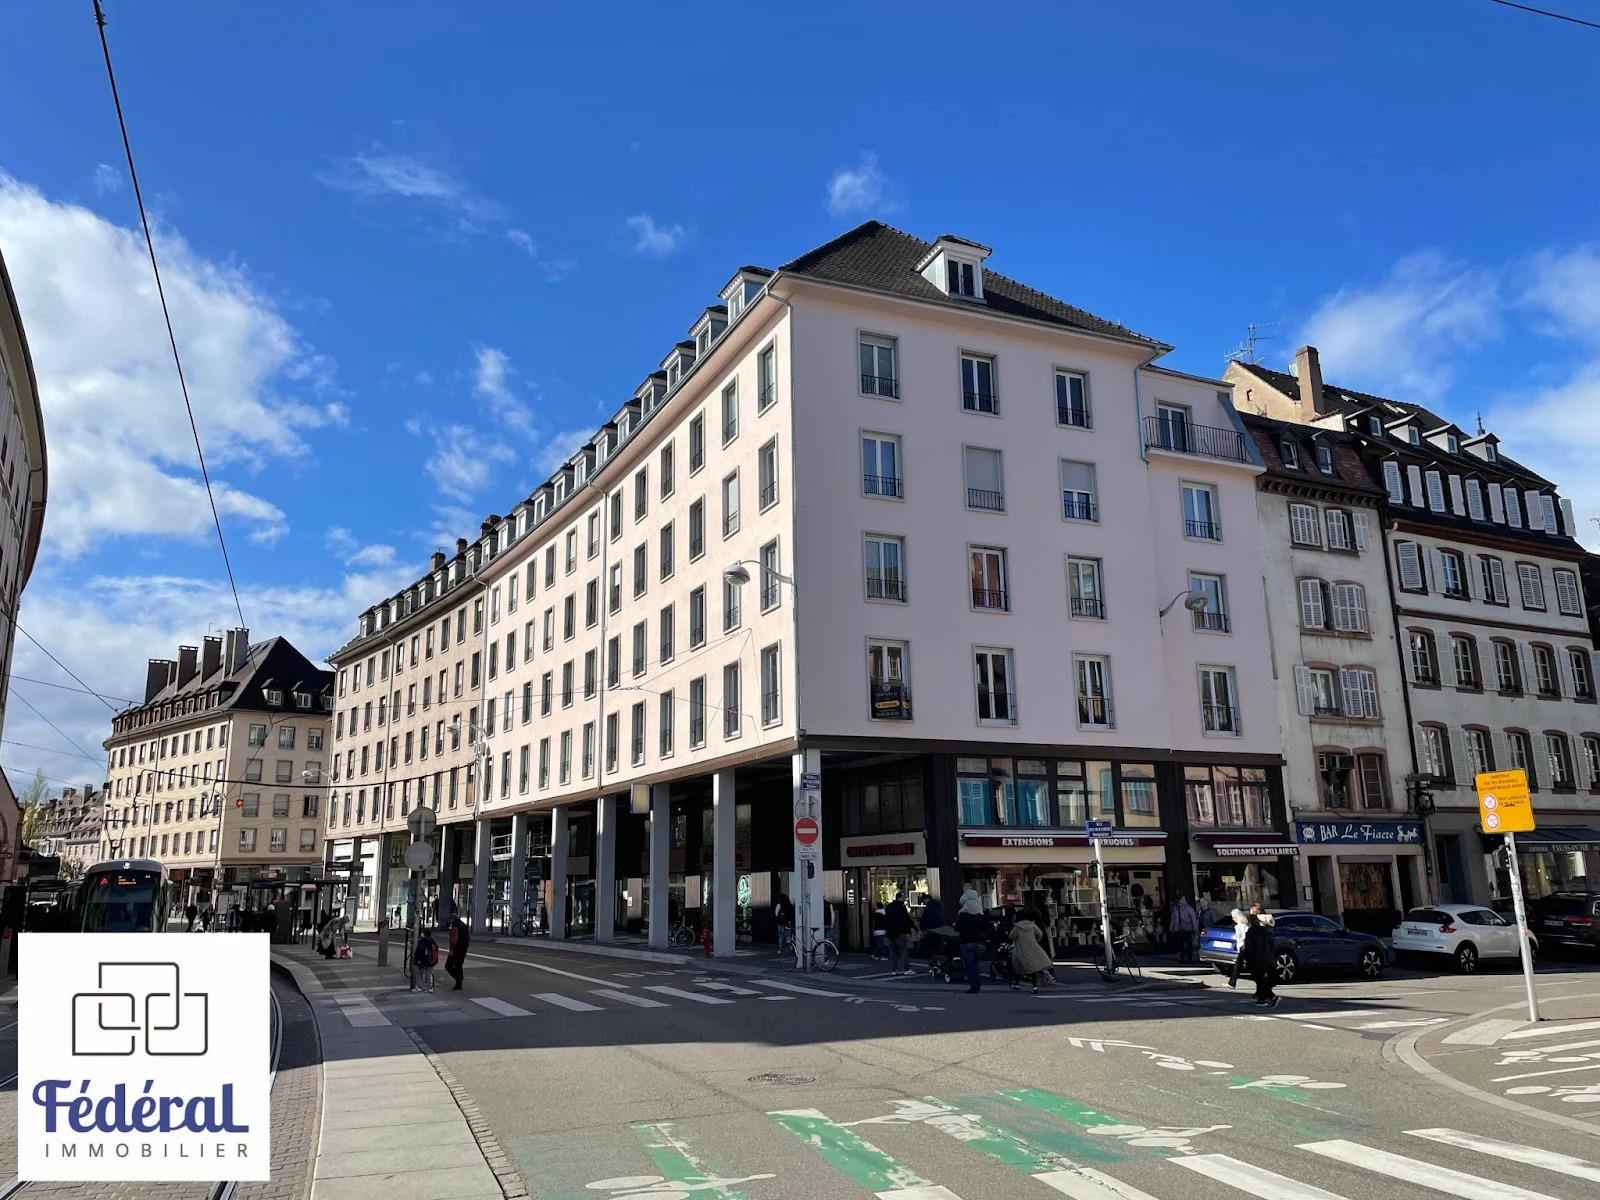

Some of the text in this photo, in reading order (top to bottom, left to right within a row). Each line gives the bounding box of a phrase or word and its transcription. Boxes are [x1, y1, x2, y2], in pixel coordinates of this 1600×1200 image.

[1320, 824, 1394, 841] BAR Le Fiacre
[1001, 838, 1134, 847] EXTENSIONS PRRUQUES
[1217, 847, 1298, 856] SOLUTIONS CAPILLAIRES
